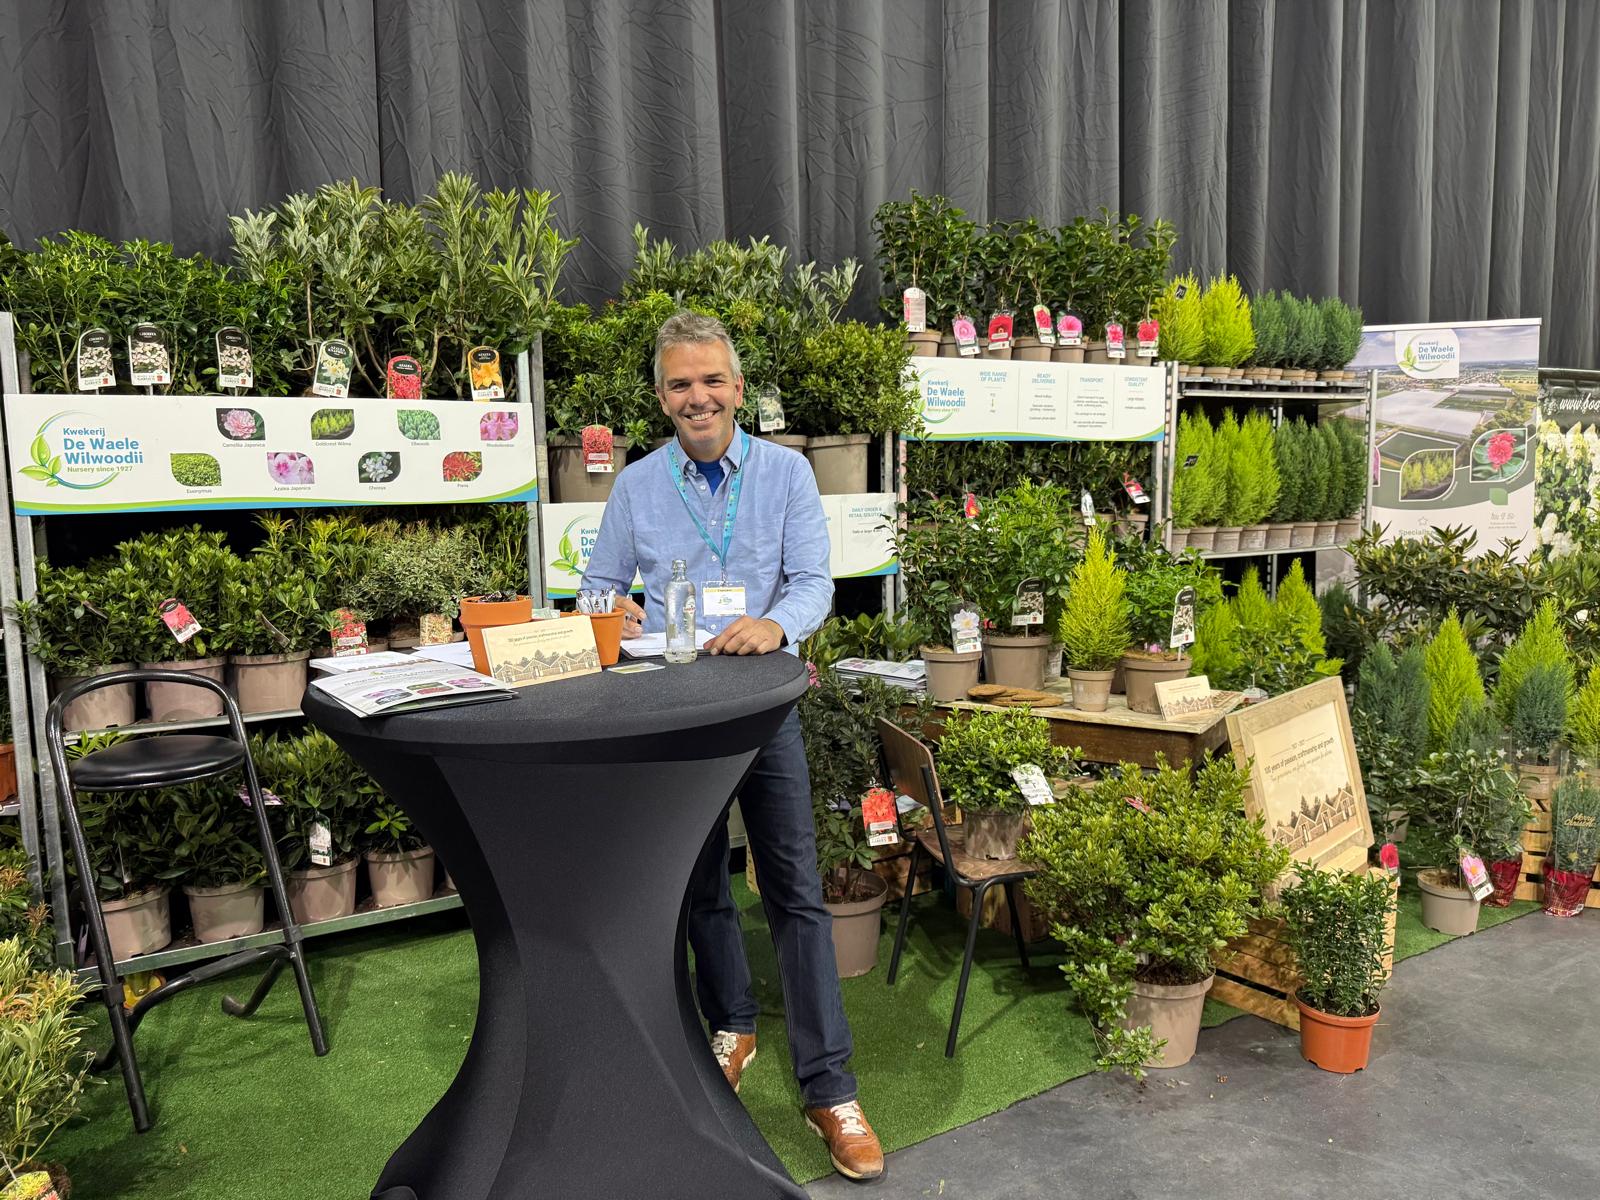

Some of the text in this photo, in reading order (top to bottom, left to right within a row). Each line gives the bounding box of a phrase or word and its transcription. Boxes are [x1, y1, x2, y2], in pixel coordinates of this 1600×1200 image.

[1430, 345, 1454, 353] Waele
[1418, 352, 1456, 360] Wilwoodii
[927, 379, 949, 387] Kwekerij
[927, 387, 965, 396] De Waele
[927, 397, 966, 407] Wilwoodii
[63, 427, 106, 437] Kwekerij
[64, 437, 140, 450] De Waele
[65, 451, 144, 464] Wilwoodii
[581, 537, 595, 546] De
